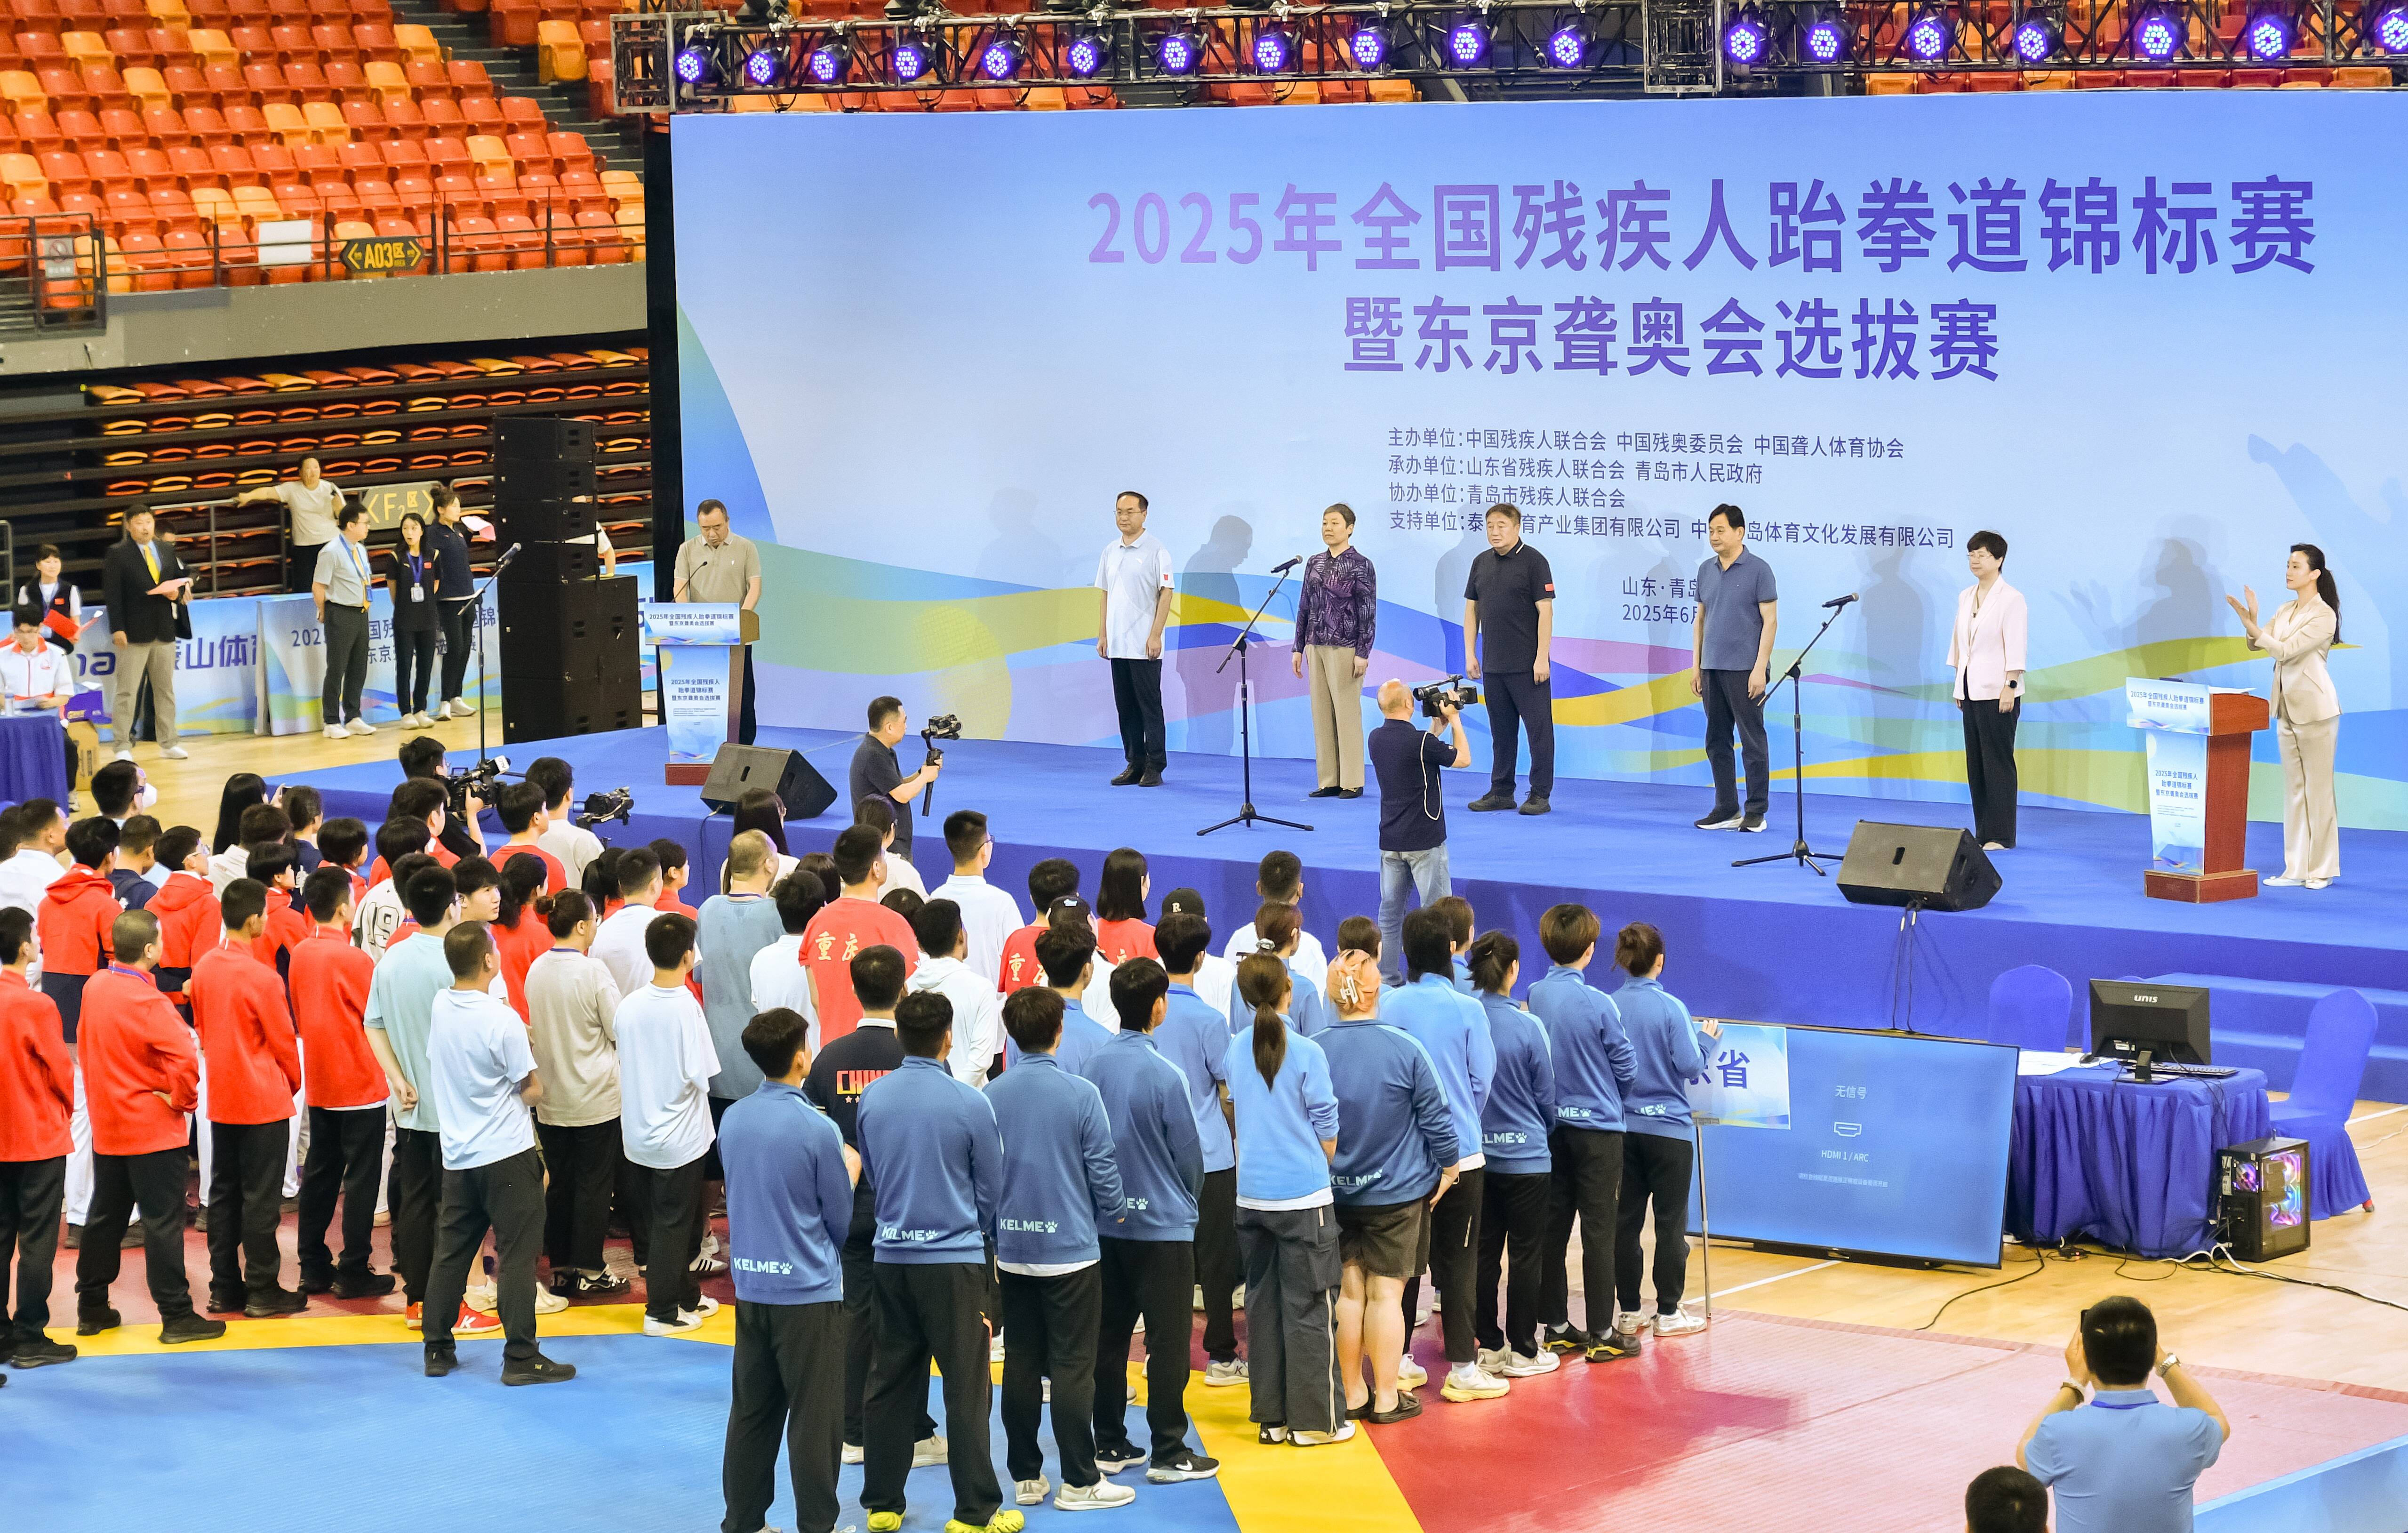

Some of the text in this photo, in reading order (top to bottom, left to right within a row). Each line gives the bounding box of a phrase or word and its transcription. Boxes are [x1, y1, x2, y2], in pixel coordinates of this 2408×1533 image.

[1087, 175, 2316, 274] 2025年全国残疾人跆拳道锦标赛
[364, 242, 405, 268] A03区
[1344, 296, 2000, 382] 暨东京聋奥会选拔赛
[1388, 427, 1904, 459] 主办单位:中国残疾人联合会 中国残奥委员会 中国聋人体育协会
[1389, 455, 1762, 485] 承办单位:山东省残疾人联合会 青岛市人民政府
[1390, 510, 1953, 549] 支持单位:泰育产业集团有限公司 中岛体育文化发展有限公司
[1172, 902, 1182, 913] R
[1835, 1085, 1867, 1100] 无信号
[1821, 1150, 1841, 1159] HDMI
[1854, 1154, 1869, 1162] ARC
[881, 1225, 925, 1241] KELME
[1000, 1218, 1044, 1233] KELME
[734, 1257, 779, 1274] KELME
